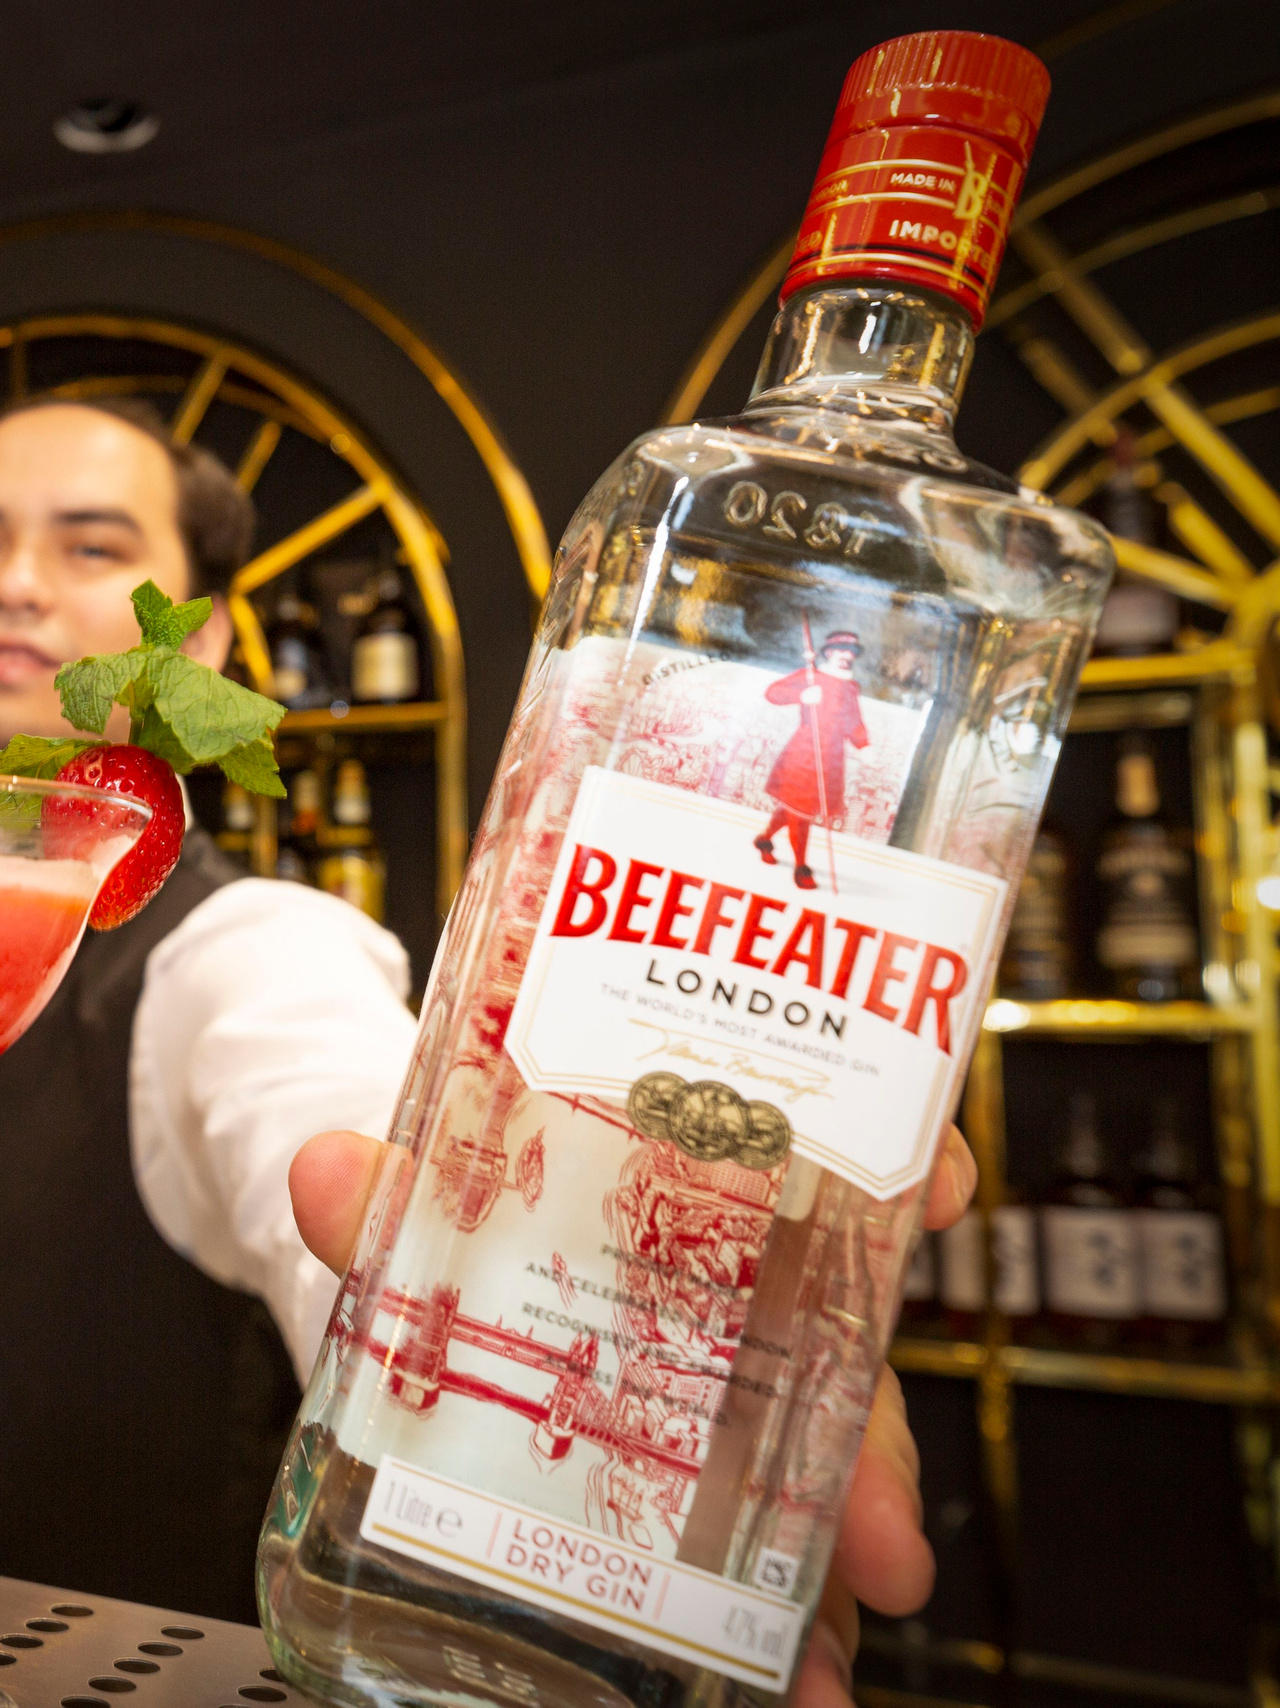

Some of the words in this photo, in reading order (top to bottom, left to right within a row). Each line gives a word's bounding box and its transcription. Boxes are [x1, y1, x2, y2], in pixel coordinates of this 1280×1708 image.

[890, 172, 937, 188] MADE
[938, 178, 956, 194] IN
[549, 843, 969, 1058] BEEFEATER
[601, 983, 629, 1001] THE
[714, 1018, 758, 1039] MOST
[645, 958, 848, 1040] LONDON
[506, 1543, 575, 1585] DRY
[586, 1574, 646, 1613] GIN
[512, 1518, 653, 1587] LONDON
